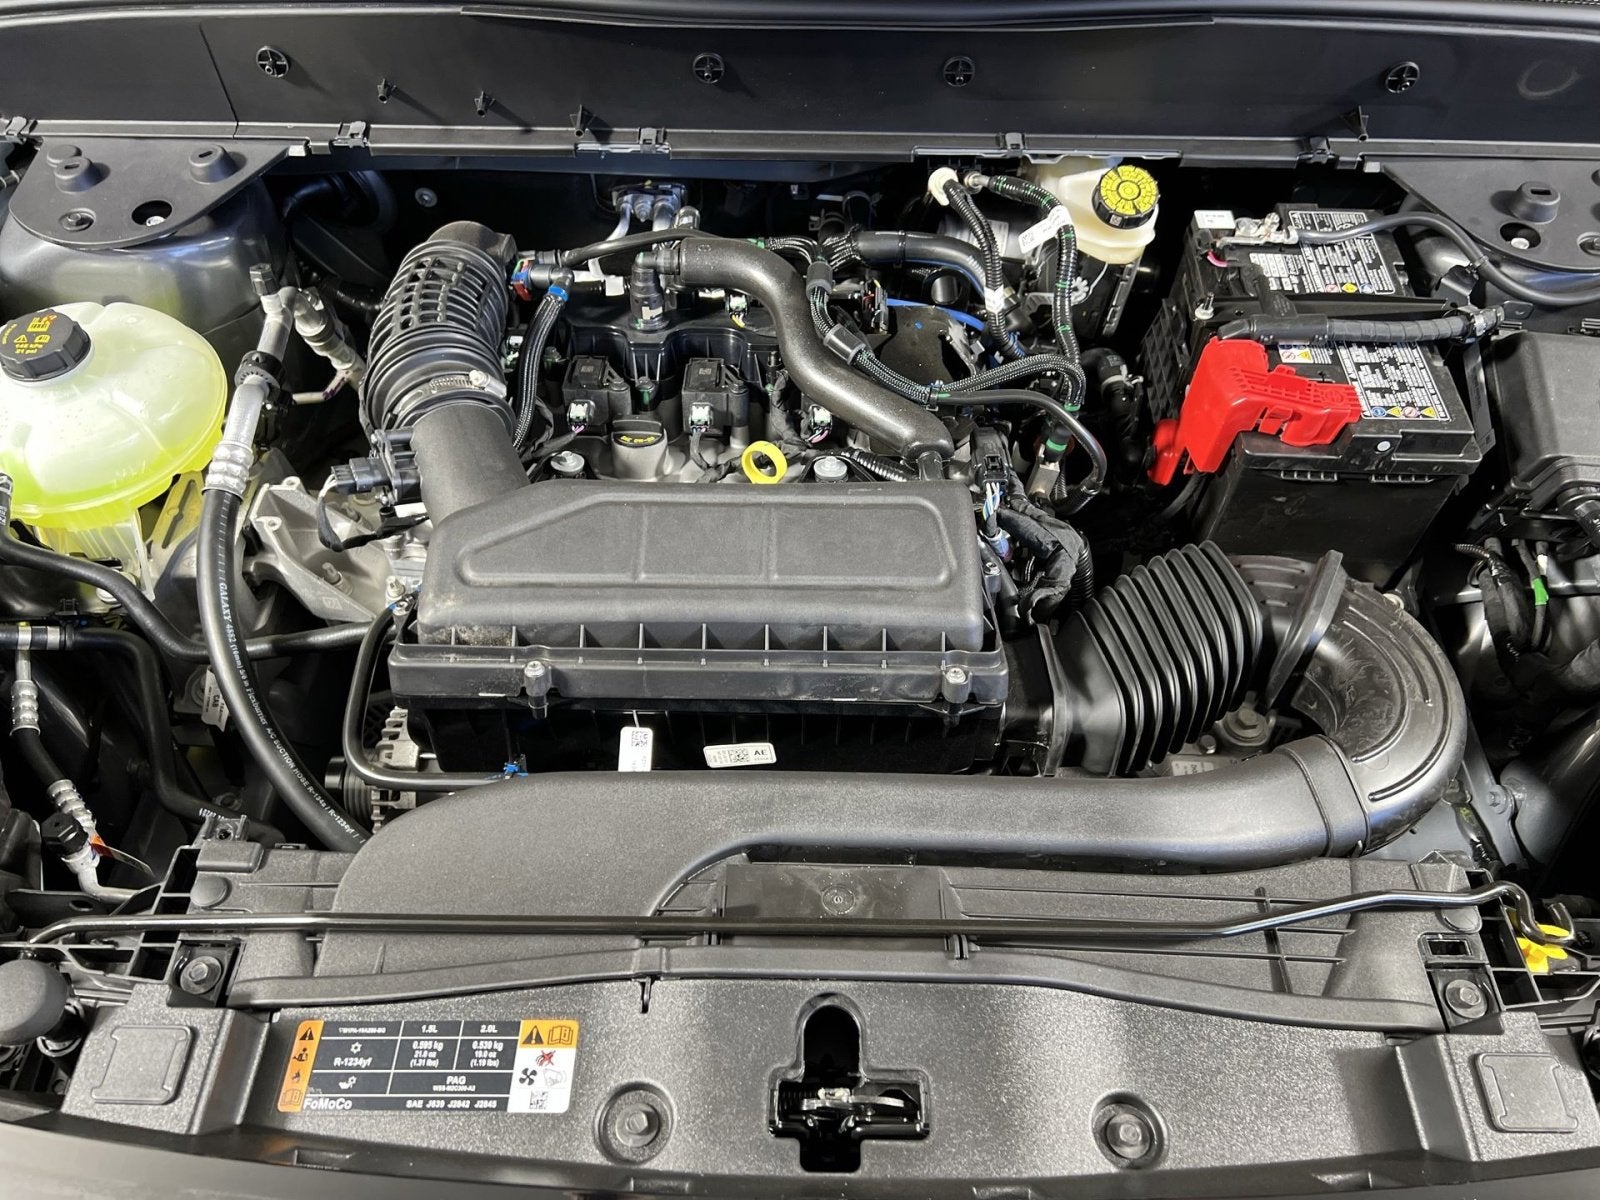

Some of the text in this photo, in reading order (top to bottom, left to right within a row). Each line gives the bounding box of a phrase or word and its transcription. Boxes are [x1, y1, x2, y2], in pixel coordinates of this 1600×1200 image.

[212, 695, 220, 707] CAB
[219, 582, 232, 622] GALAXY
[265, 727, 277, 740] A/C
[273, 740, 296, 769] SUCTION
[293, 768, 309, 787] HOSE
[307, 785, 327, 808] R-134a
[328, 808, 356, 834] R-1234yf
[421, 1024, 438, 1033] 1.5L
[480, 1024, 498, 1033] 2.0L
[433, 1040, 444, 1052] kg
[493, 1040, 504, 1052] kg
[333, 1057, 373, 1069] R-1234yf
[446, 1075, 467, 1085] PAG
[302, 1098, 353, 1110] FoMoCo
[405, 1099, 424, 1108] SAE
[425, 1099, 446, 1108] J639
[473, 1099, 498, 1108] J2845
